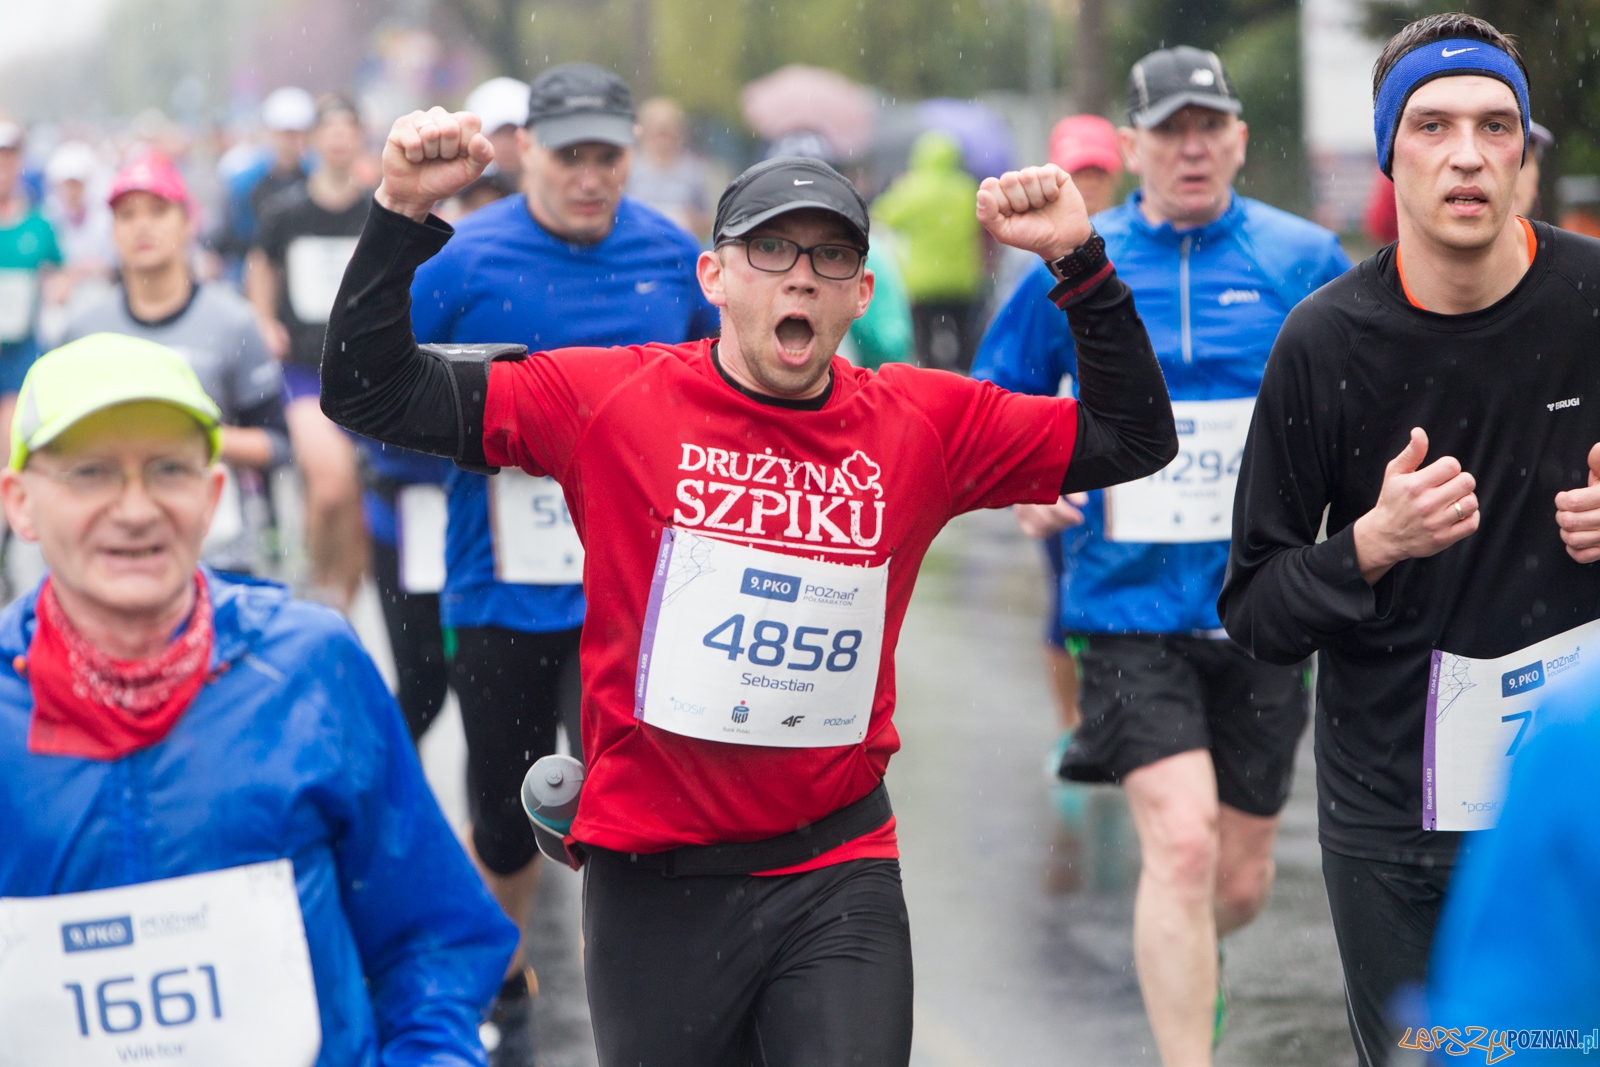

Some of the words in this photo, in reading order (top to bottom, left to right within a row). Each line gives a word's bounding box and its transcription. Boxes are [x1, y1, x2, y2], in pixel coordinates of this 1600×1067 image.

[677, 443, 853, 496] DRUŻYNA
[673, 479, 886, 547] SZPIKU
[762, 579, 791, 595] PKO
[702, 613, 863, 673] 4858
[740, 672, 815, 693] Sebastian
[1430, 663, 1439, 695] 17.04.2016
[1519, 670, 1540, 687] PKO
[63, 964, 222, 1038] 1661
